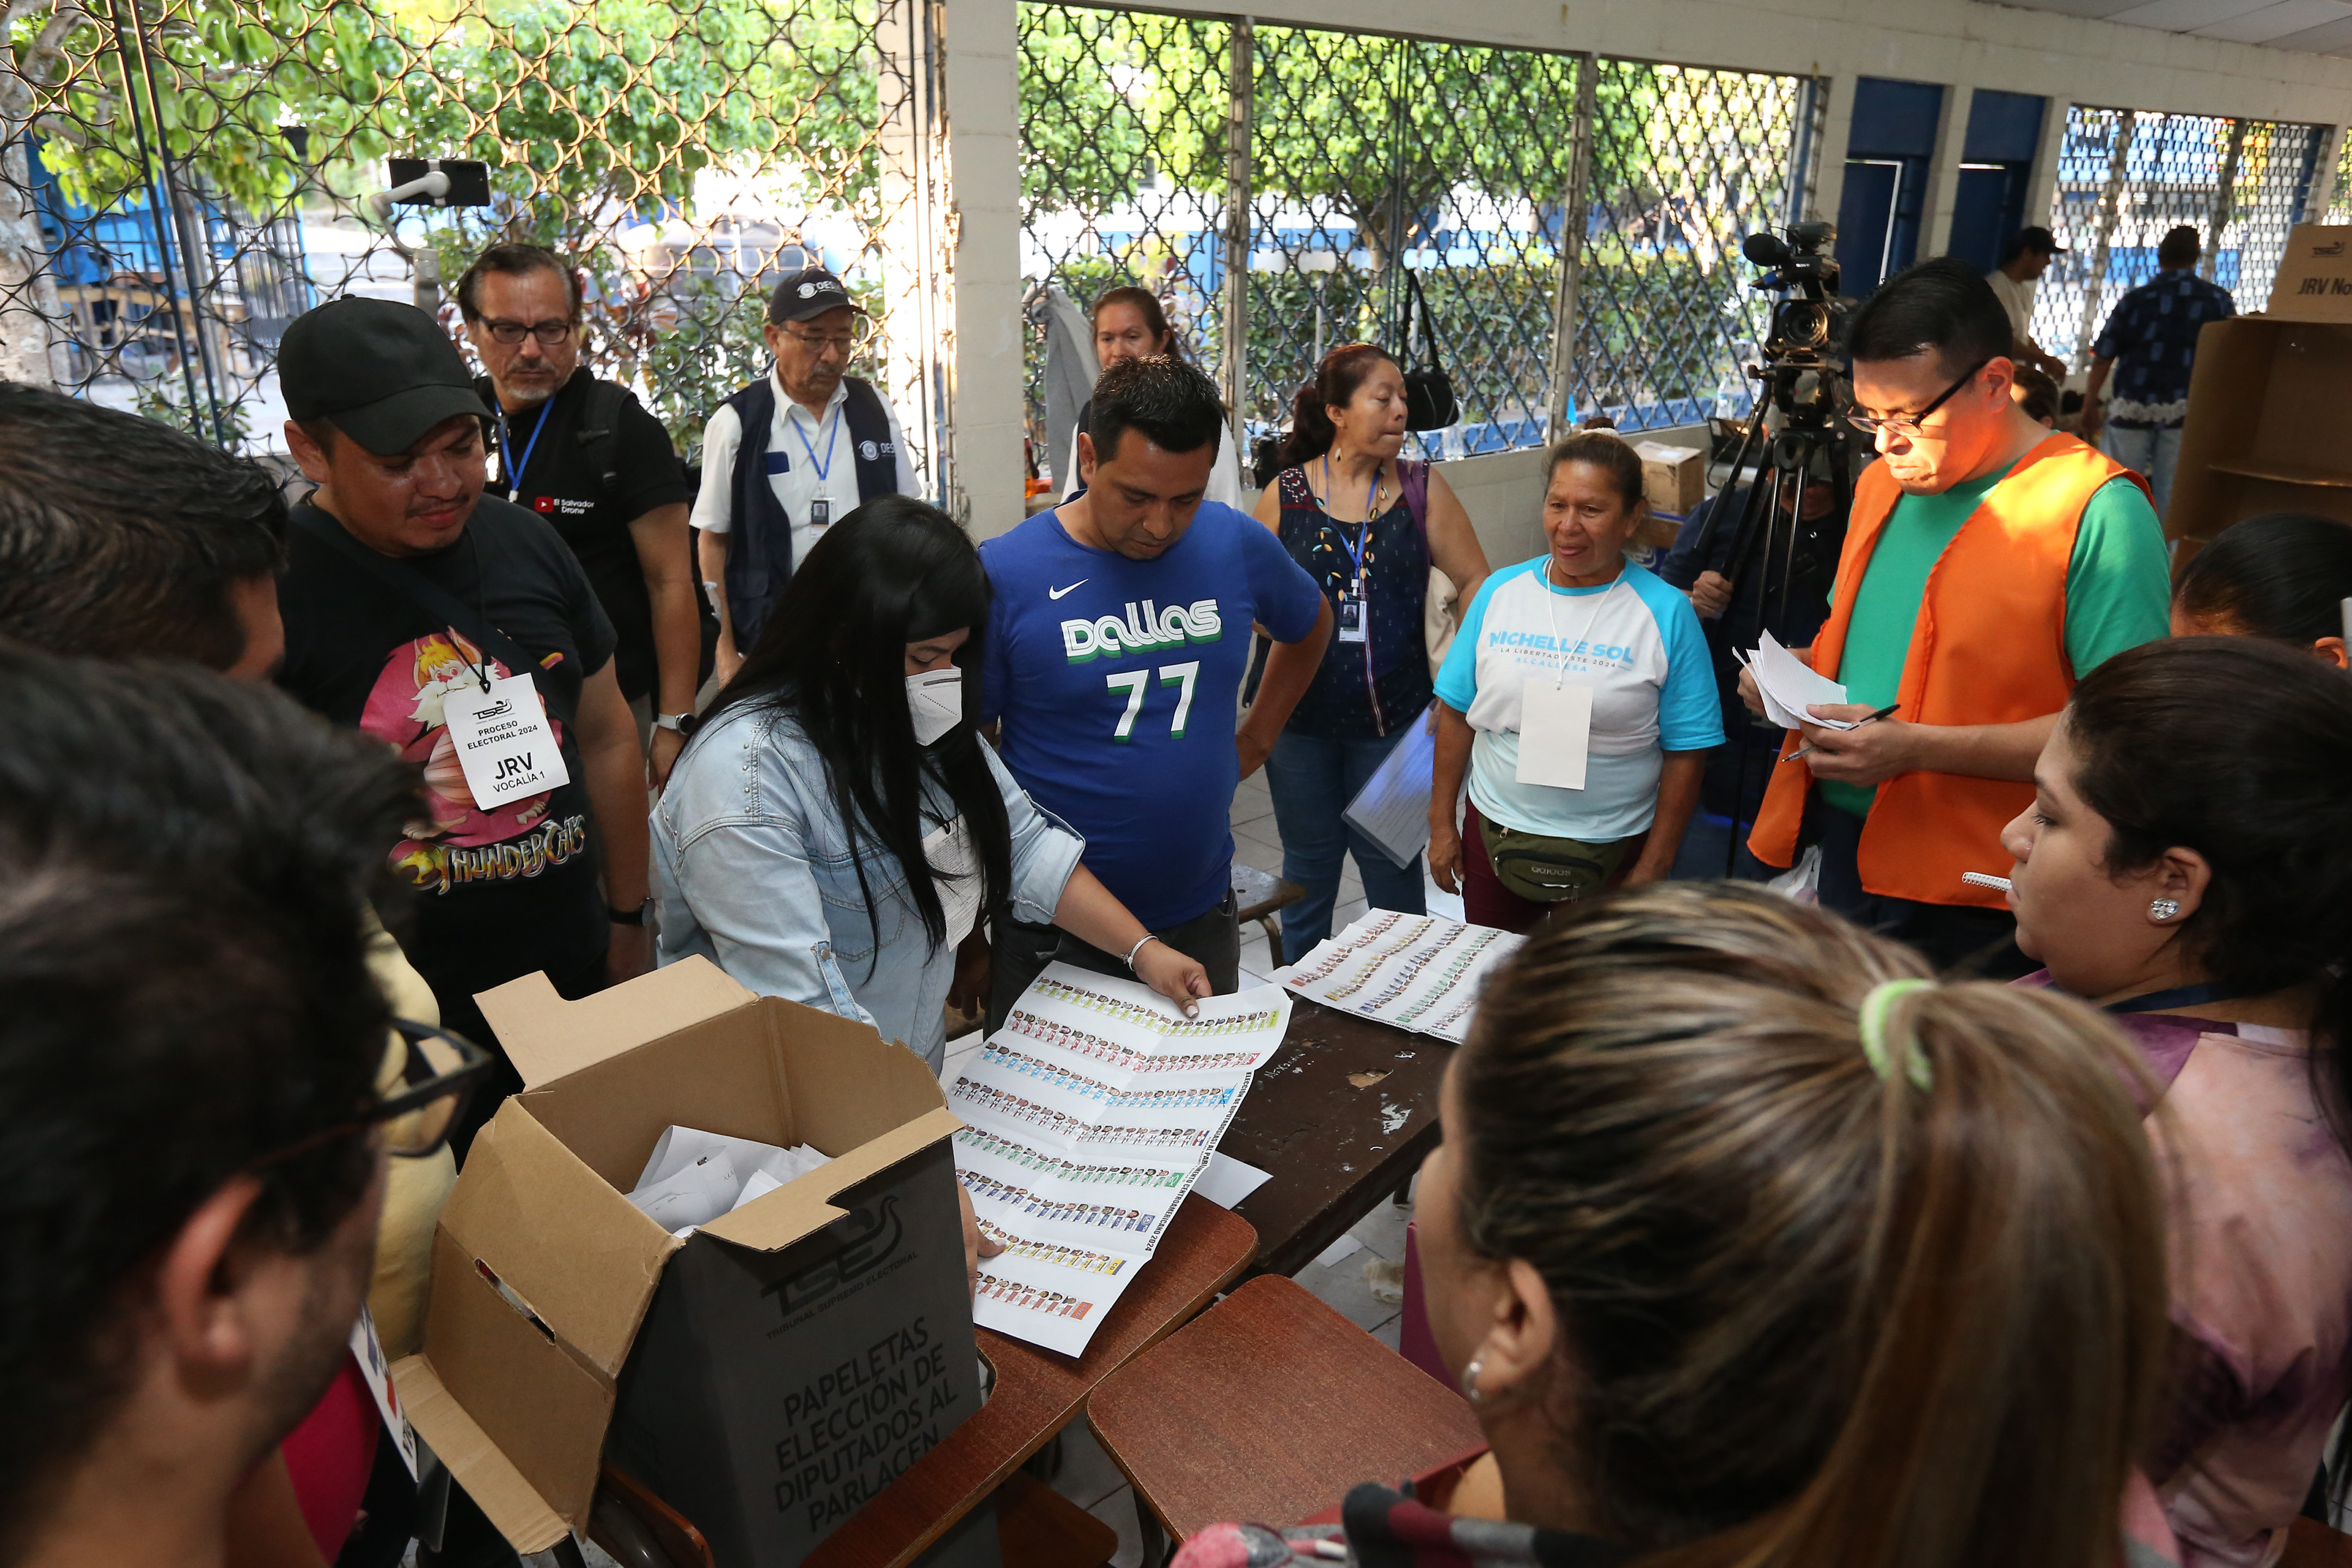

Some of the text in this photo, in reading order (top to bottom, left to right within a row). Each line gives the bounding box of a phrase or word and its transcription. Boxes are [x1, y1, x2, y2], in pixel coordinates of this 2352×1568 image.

[2298, 278, 2330, 295] JRV
[561, 499, 594, 507] Salvador
[561, 506, 585, 514] Drone
[1490, 631, 1634, 664] MICHELLE SOL
[1514, 648, 1559, 659] LIBERTAD
[1592, 659, 1615, 667] 2024
[1106, 660, 1200, 740] 77
[467, 725, 538, 750] ELECTORAL 2024
[478, 720, 518, 736] PROCESO
[495, 752, 532, 780] JRV
[493, 770, 545, 793] VOCALÍA 1
[1237, 1072, 1252, 1098] ELECCIÓN
[1153, 1183, 1190, 1235] CENTROAMERICANO
[1145, 1235, 1158, 1251] 2024
[765, 1252, 919, 1340] TRIBUNAL SUPREMO ELECTORAL
[783, 1316, 929, 1428] PAPELETAS
[775, 1342, 948, 1473] ELECCIÓN DE
[774, 1376, 959, 1512] DIPUTADOS AL
